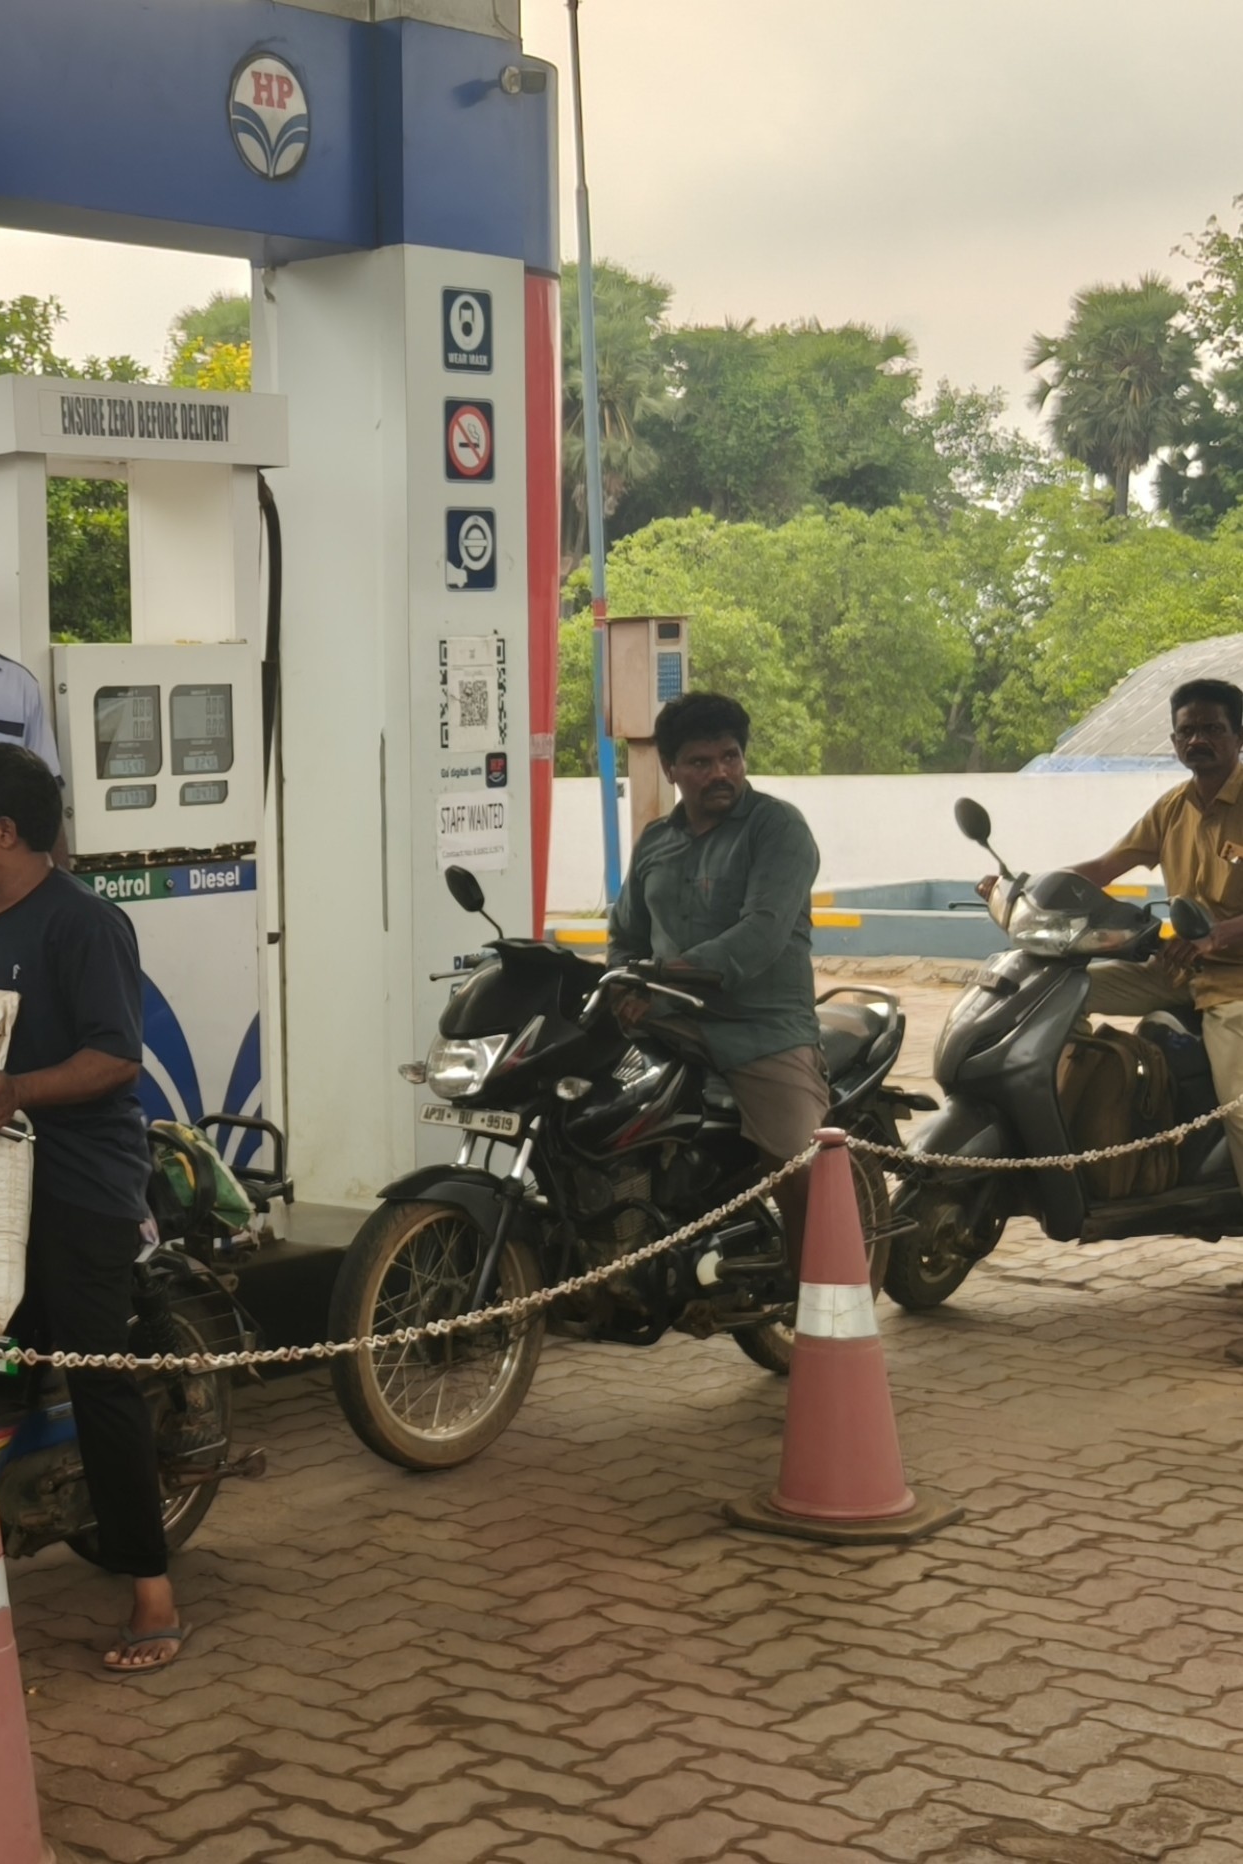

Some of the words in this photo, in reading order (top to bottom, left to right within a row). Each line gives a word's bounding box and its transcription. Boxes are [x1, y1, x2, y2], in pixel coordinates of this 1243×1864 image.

[250, 70, 294, 110] HP
[60, 396, 106, 437] ENSURE
[107, 398, 135, 438] ZERO
[137, 400, 179, 440] BEFORE
[180, 403, 230, 442] DELIVERY
[441, 805, 466, 834] STAFF
[467, 803, 504, 831] WANTED
[94, 871, 151, 898] Petrol
[189, 865, 240, 890] Diesel
